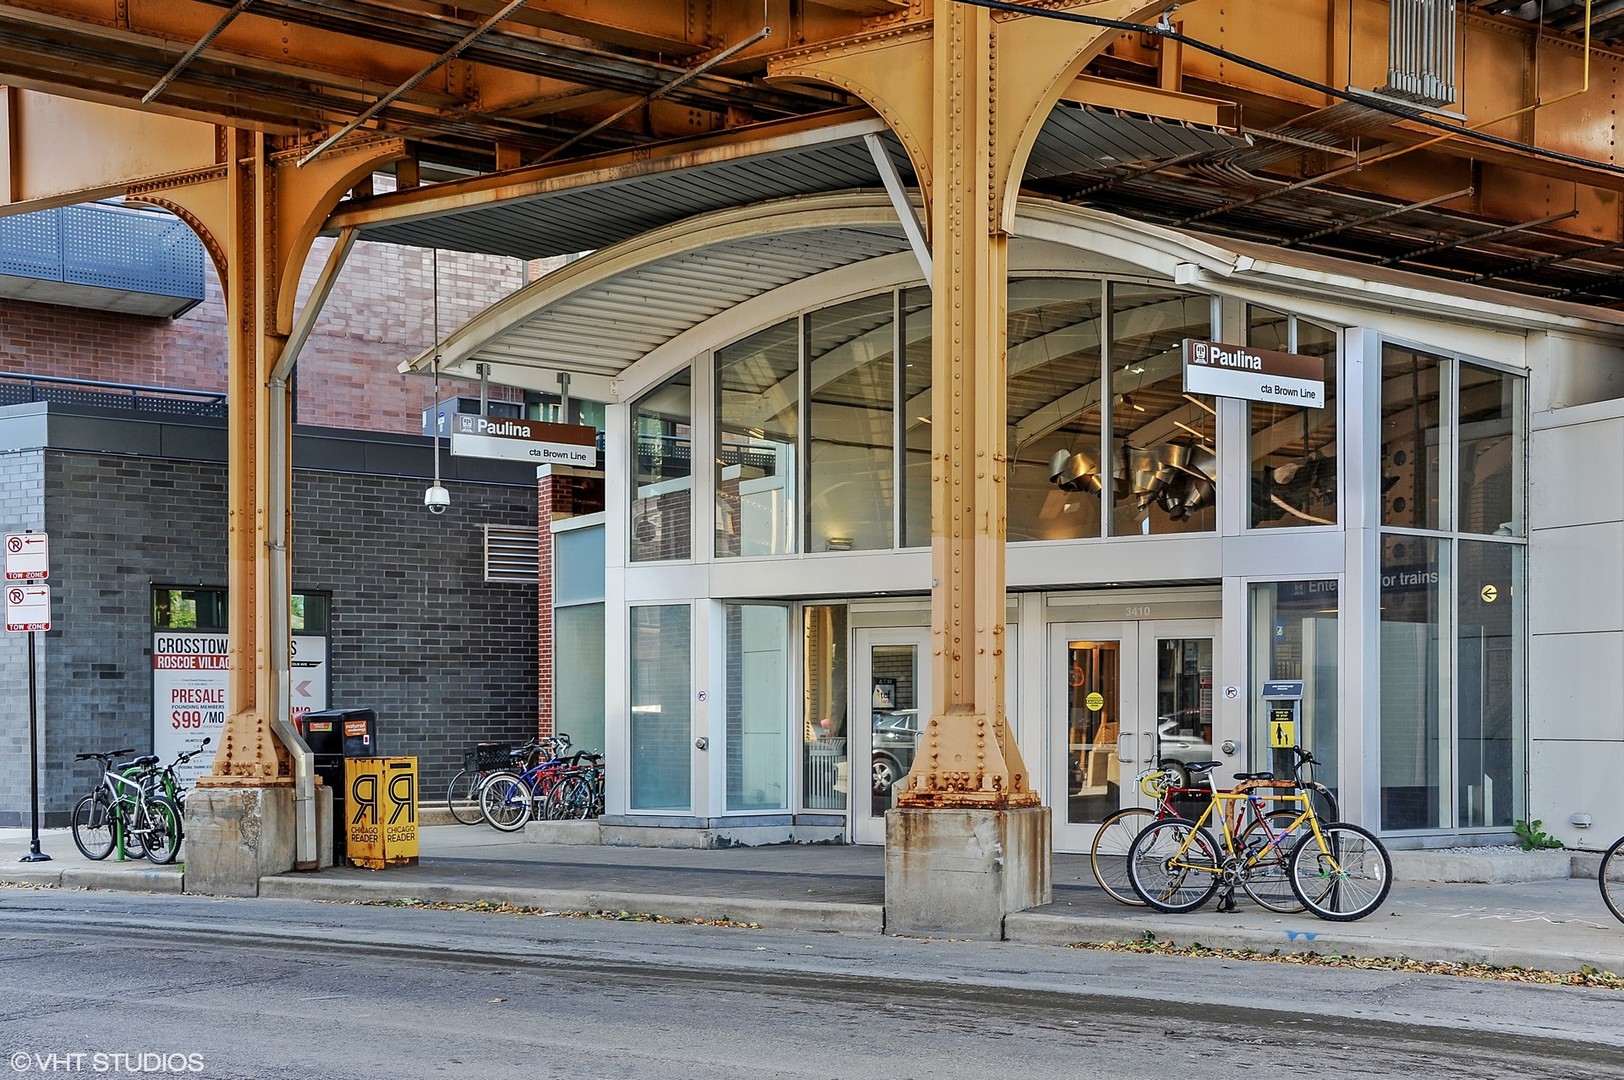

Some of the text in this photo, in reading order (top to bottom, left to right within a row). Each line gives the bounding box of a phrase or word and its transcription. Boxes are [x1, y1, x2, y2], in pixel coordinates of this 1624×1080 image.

[1210, 346, 1262, 370] Paulina
[1261, 384, 1316, 399] cta Brown Line
[478, 419, 530, 438] Paulina
[529, 448, 586, 461] cta Brown Line
[1308, 571, 1438, 592] Ente or trains
[1125, 606, 1150, 616] 3410
[158, 638, 228, 654] CROSSTOW
[158, 656, 230, 669] ROSCOE VILLAG
[172, 688, 224, 703] PRESALE
[172, 710, 200, 729] $99
[387, 826, 414, 834] CHICAGO
[387, 832, 415, 842] READER
[352, 834, 378, 842] READER
